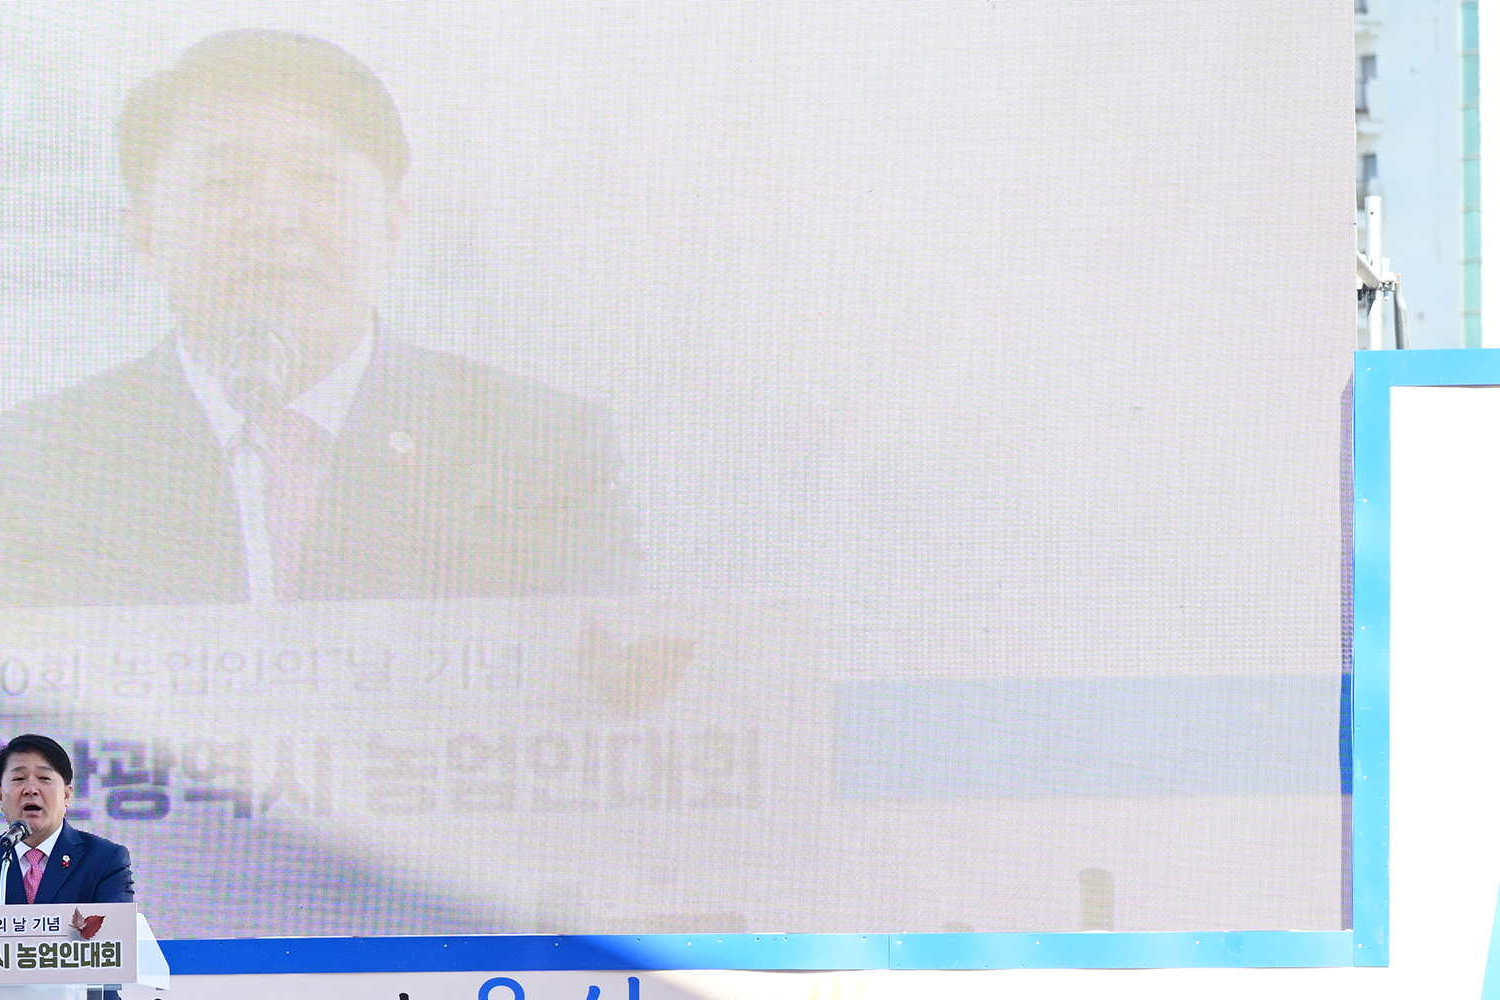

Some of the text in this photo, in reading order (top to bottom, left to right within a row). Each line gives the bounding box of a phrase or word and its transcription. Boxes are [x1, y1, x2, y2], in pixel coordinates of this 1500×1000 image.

[13, 917, 26, 932] 날
[33, 916, 60, 932] 기념
[17, 941, 121, 969] 농업인대회
